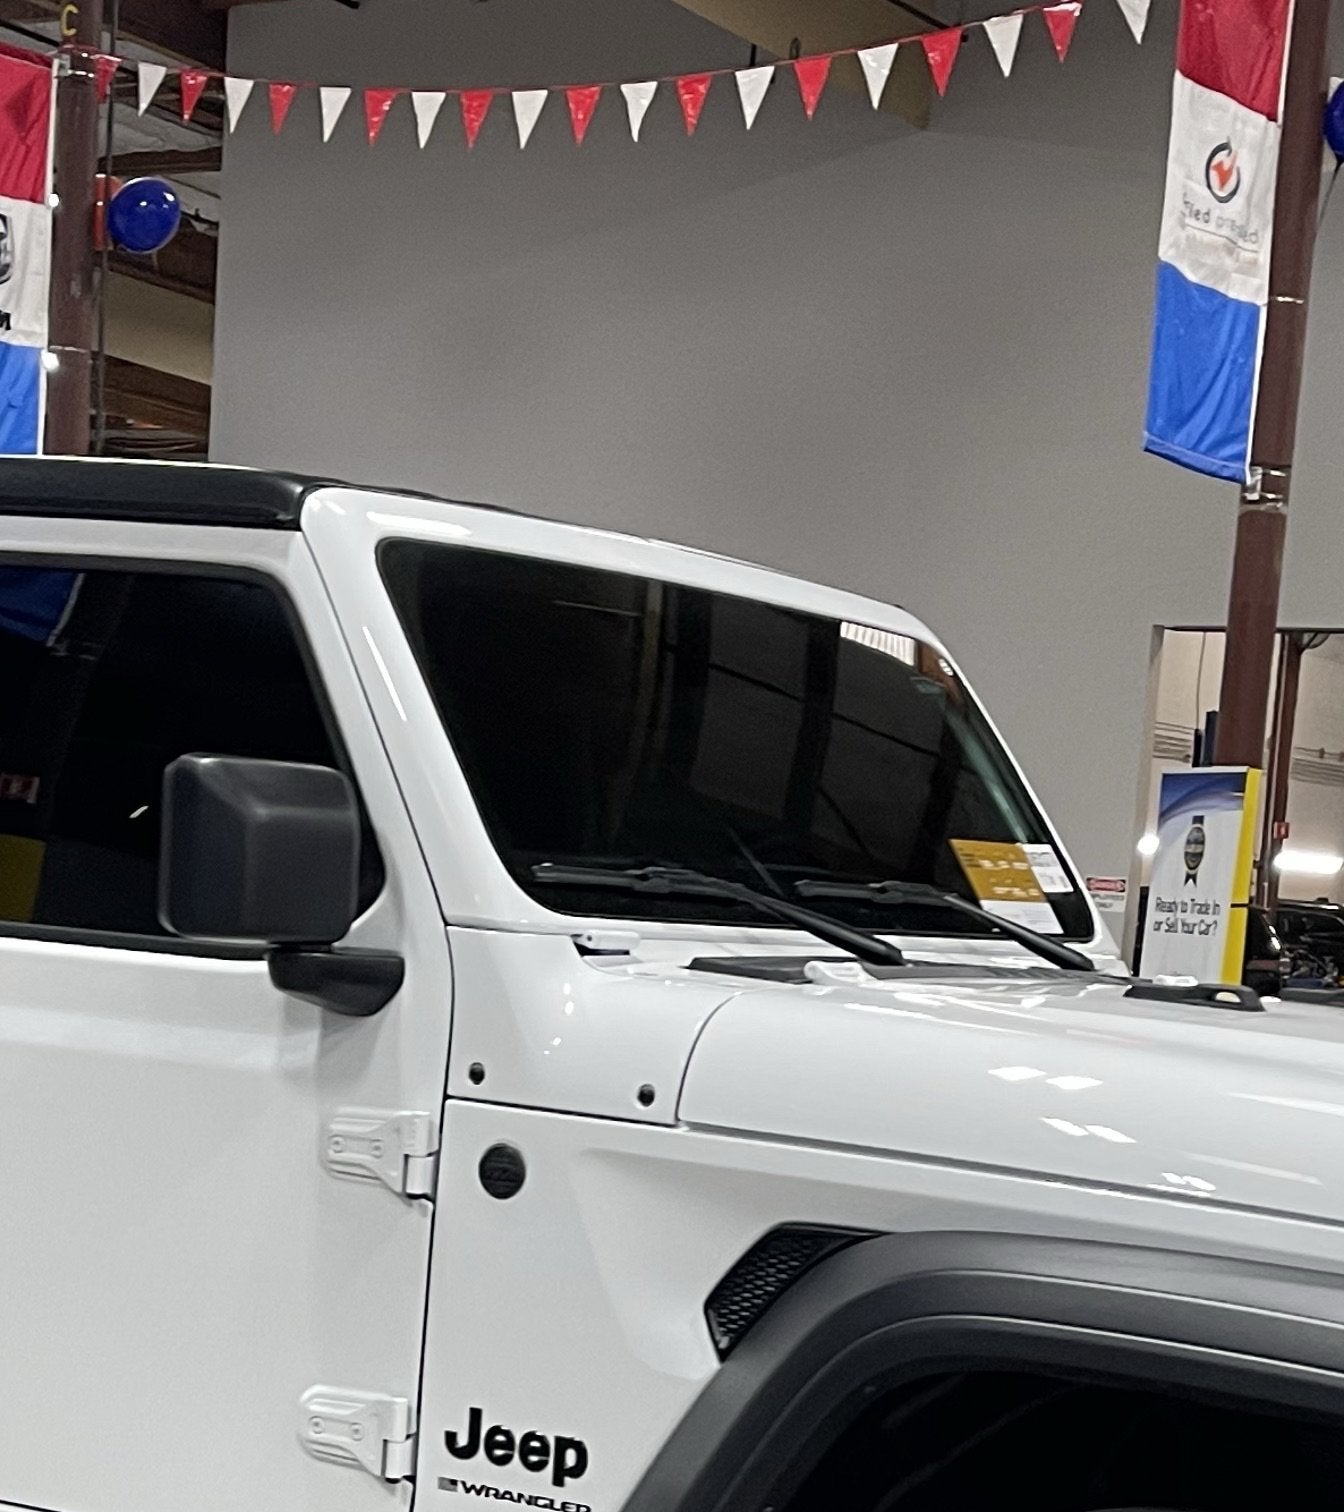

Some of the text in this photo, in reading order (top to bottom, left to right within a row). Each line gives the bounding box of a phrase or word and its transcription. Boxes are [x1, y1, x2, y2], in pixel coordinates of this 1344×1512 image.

[1155, 896, 1178, 917] Ready
[1190, 898, 1211, 915] Trade
[1165, 917, 1178, 933] Sell
[444, 1407, 589, 1487] Jeep
